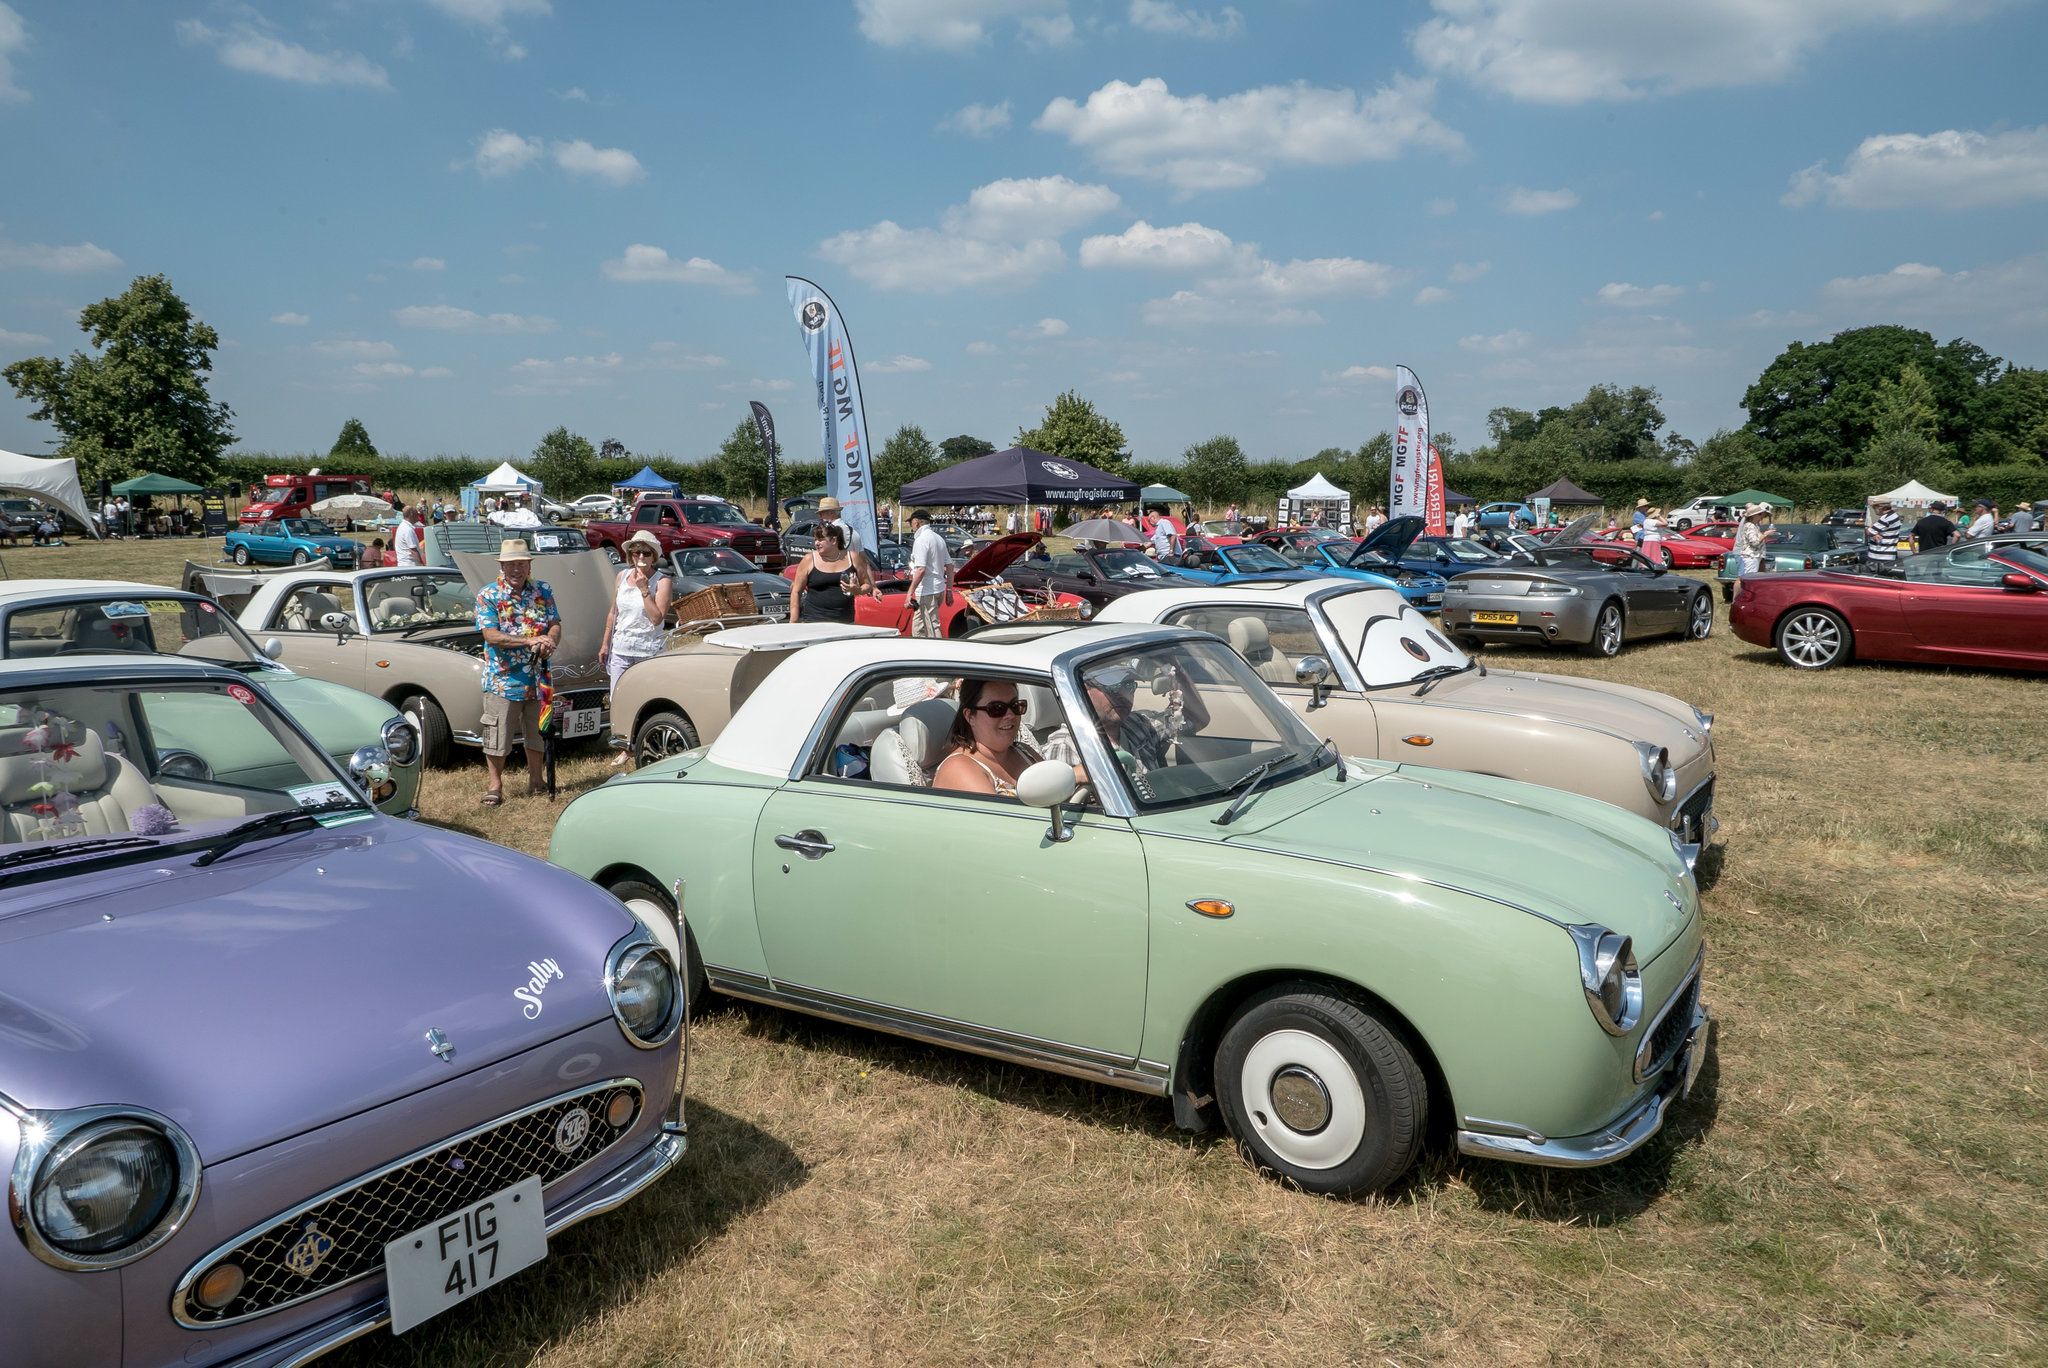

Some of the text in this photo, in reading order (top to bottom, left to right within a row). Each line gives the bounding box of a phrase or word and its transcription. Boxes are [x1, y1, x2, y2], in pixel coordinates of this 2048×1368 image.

[1395, 425, 1409, 468] MGTF
[1413, 427, 1424, 506] www.mgfregister.org
[1045, 488, 1124, 501] www.mgfregister.org
[1393, 473, 1404, 506] MGF
[574, 721, 595, 733] 1958
[578, 712, 593, 722] FIG
[513, 957, 564, 1020] Sally
[292, 1232, 328, 1270] RAC
[438, 1202, 498, 1261] FIG
[444, 1239, 499, 1296] 417
